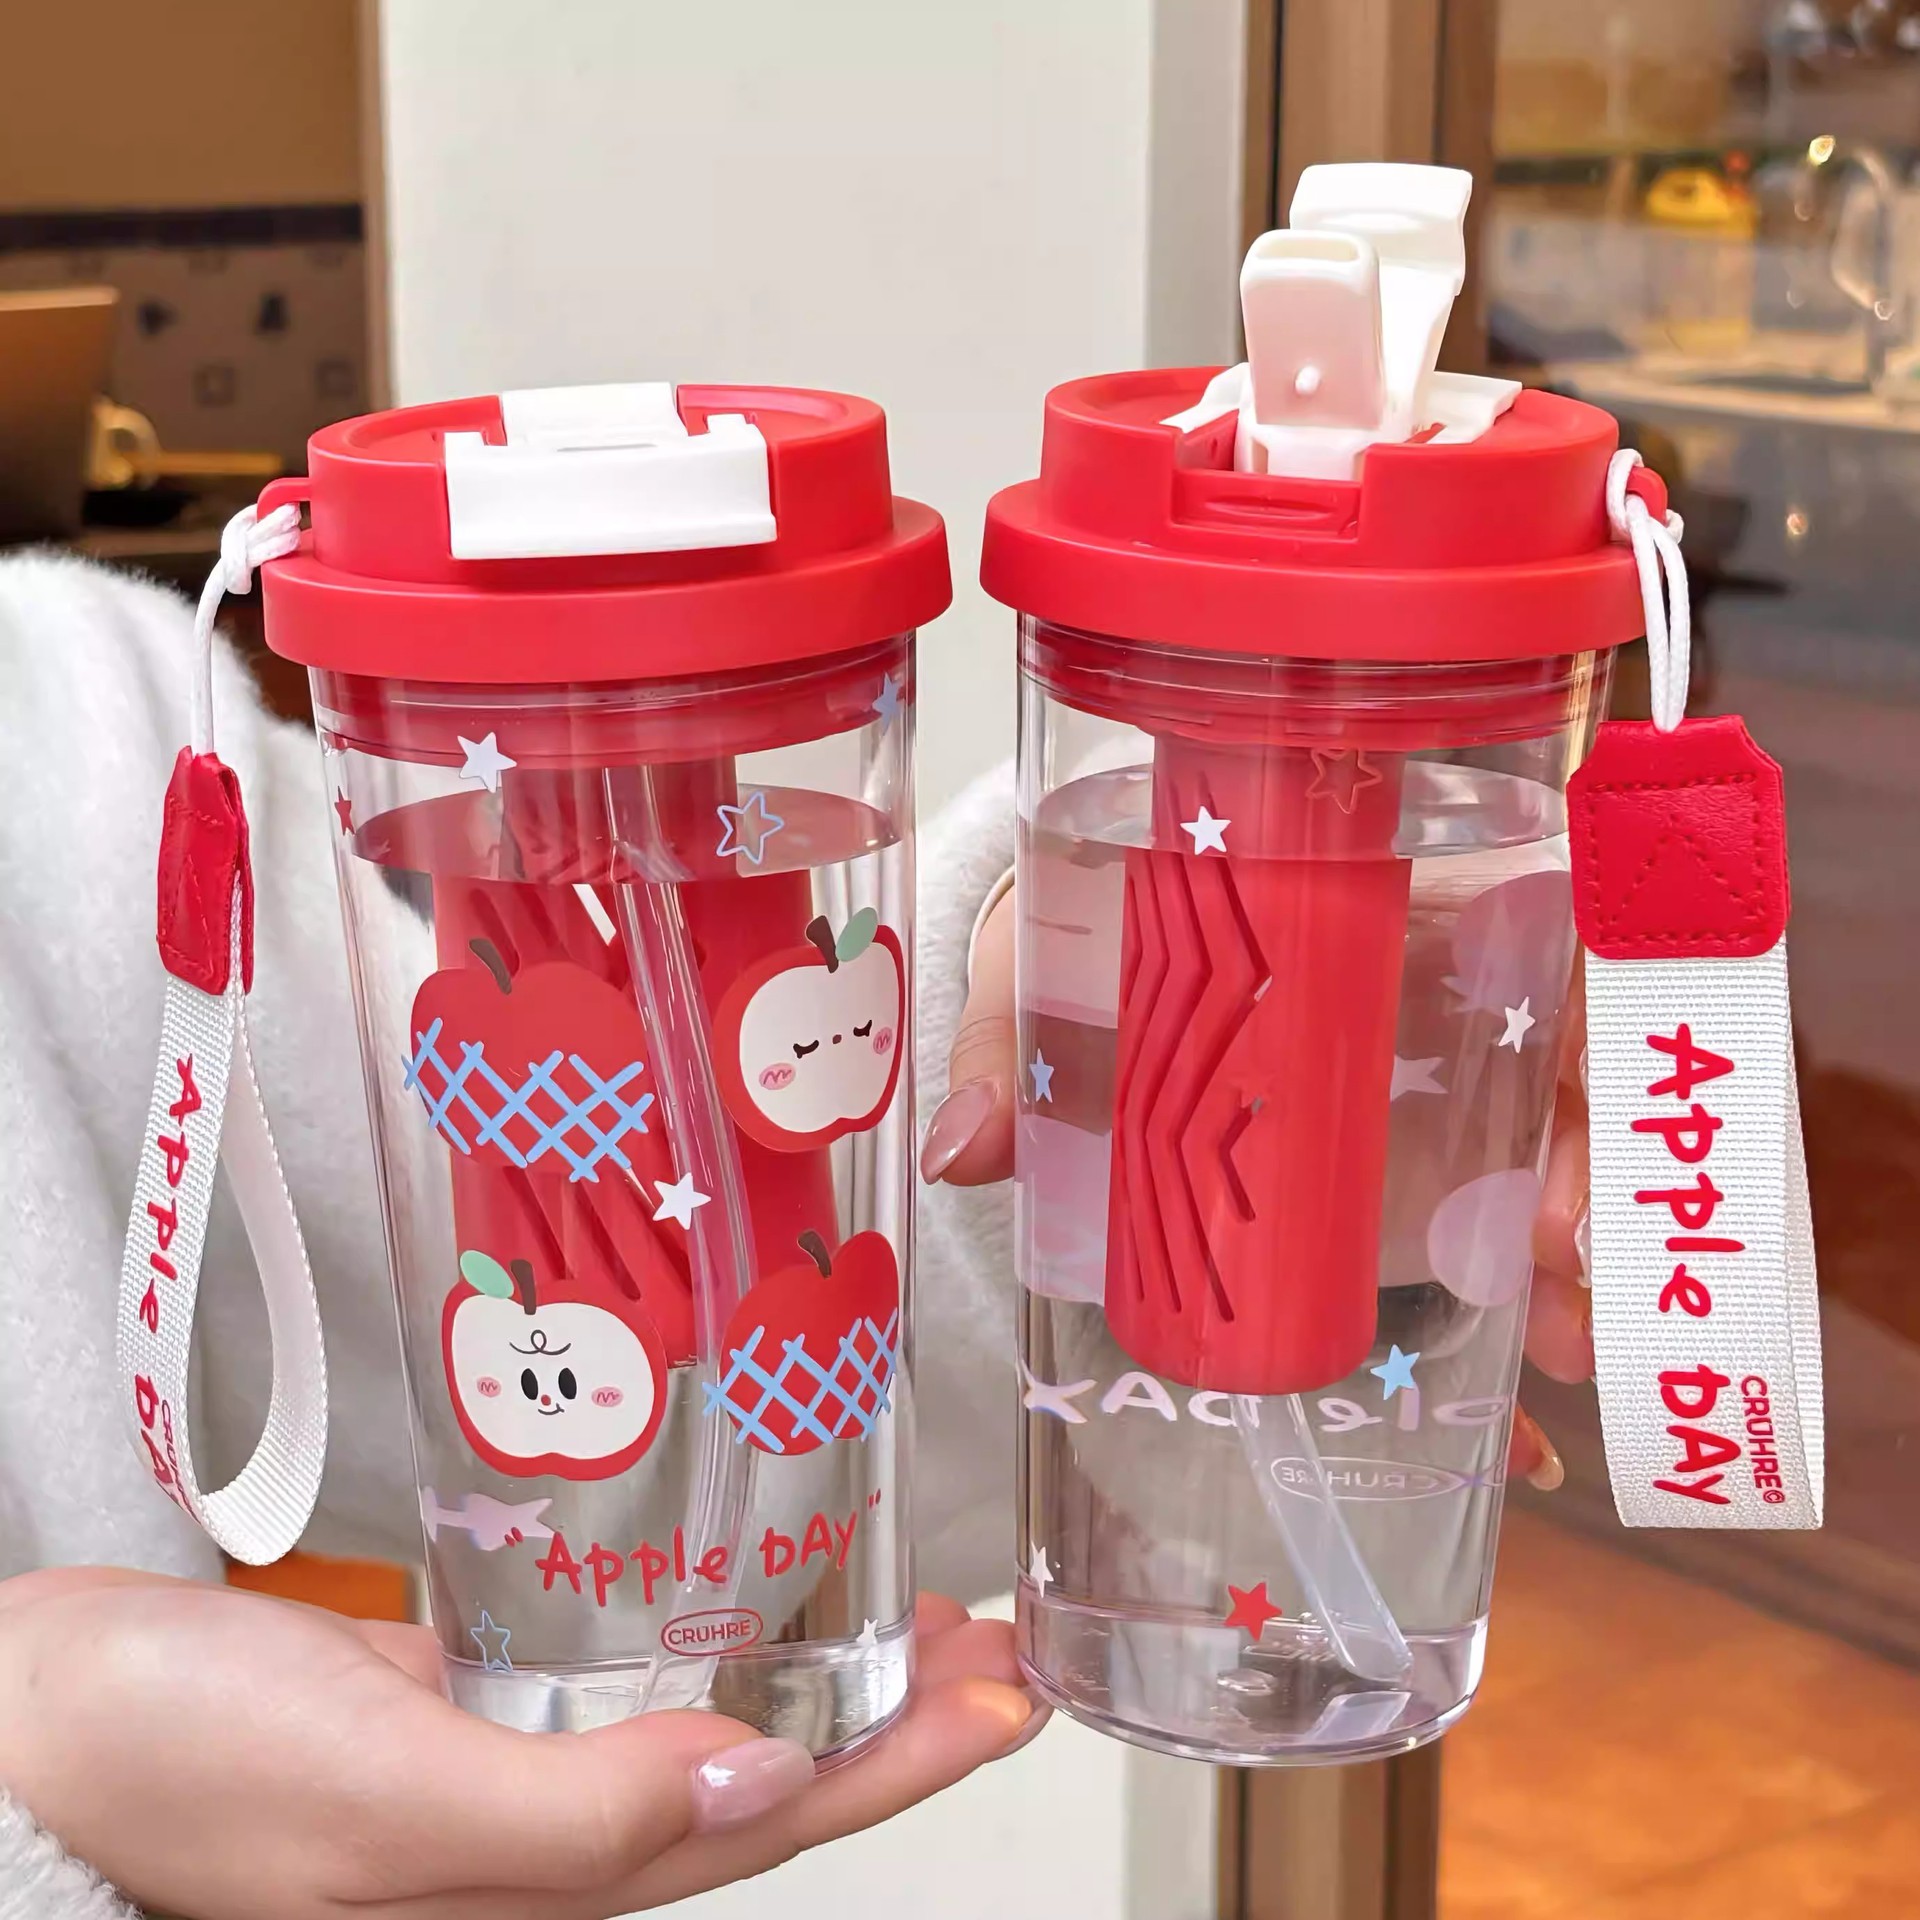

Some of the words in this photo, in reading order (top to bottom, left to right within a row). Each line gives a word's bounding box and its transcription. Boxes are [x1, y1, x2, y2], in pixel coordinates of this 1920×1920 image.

[137, 1052, 202, 1334] Apple
[1630, 1022, 1746, 1319] Apple
[1651, 1363, 1742, 1505] DAY
[667, 1618, 753, 1647] CRUHRE
